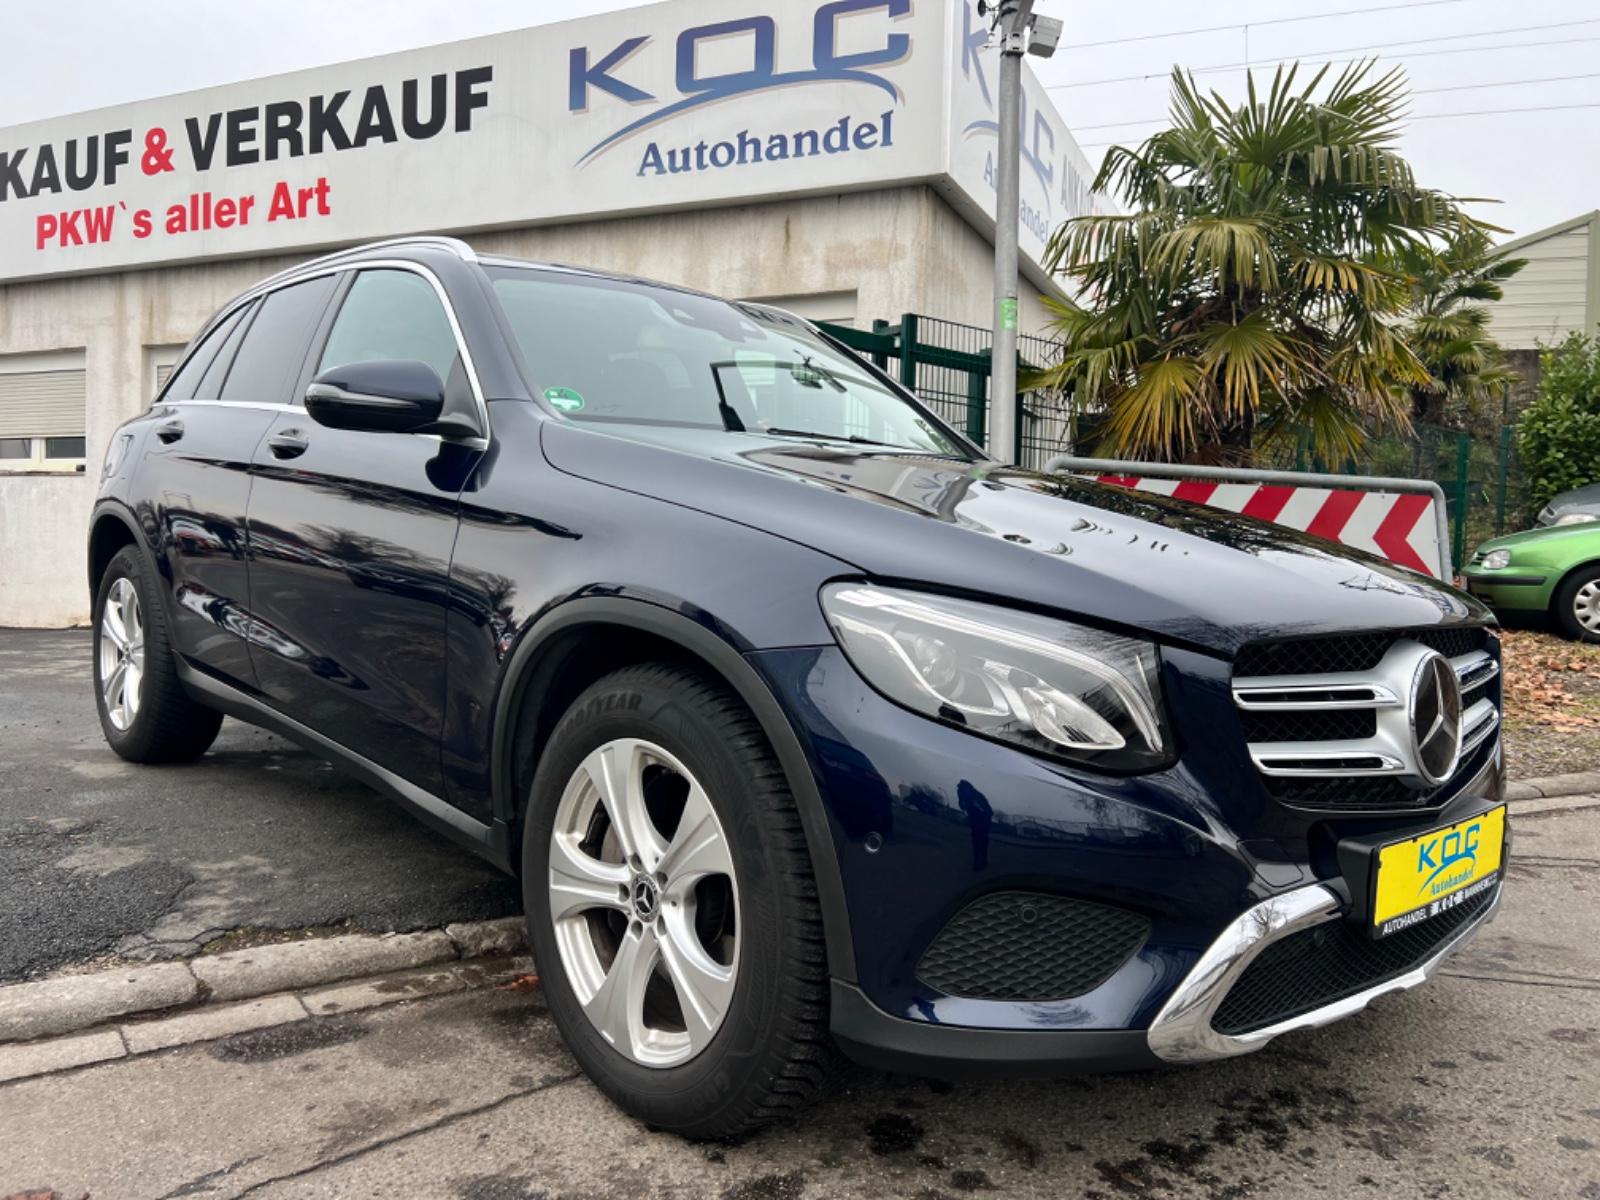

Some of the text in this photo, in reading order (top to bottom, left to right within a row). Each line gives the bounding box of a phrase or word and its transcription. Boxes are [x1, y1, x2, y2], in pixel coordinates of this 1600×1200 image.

[0, 65, 493, 200] KAUF & VERKAUF
[636, 110, 895, 177] Autohandel
[166, 192, 255, 235] aller
[267, 177, 331, 222] Art
[1382, 908, 1427, 936] AUTOHANDEL
